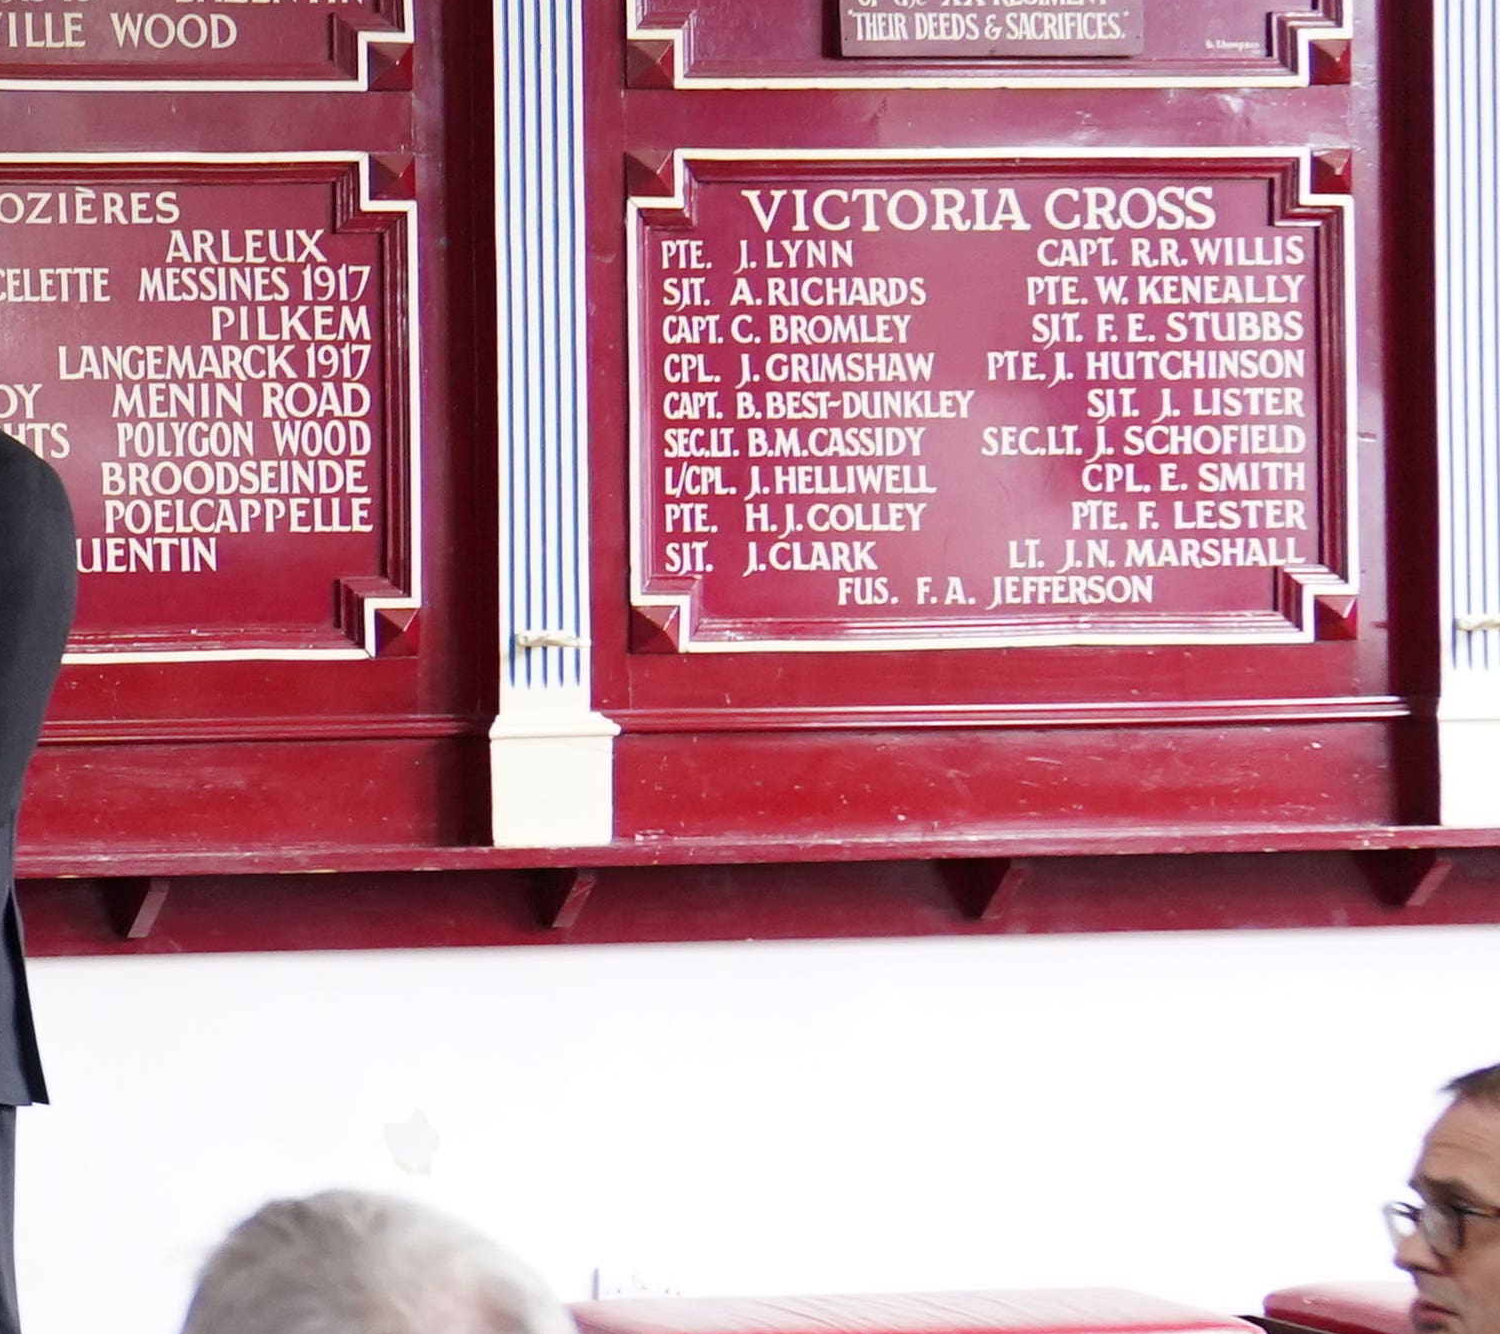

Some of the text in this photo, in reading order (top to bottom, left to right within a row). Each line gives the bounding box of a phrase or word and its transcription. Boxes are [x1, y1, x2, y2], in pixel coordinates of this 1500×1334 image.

[111, 13, 236, 48] WOOD
[915, 13, 979, 40] DEEDS
[742, 187, 1215, 232] VICTORIA CROSS
[166, 230, 326, 264] ARLEUX
[662, 240, 711, 269] PTE.
[767, 240, 852, 268] LYNN
[1038, 238, 1117, 266] CAPT.
[1191, 236, 1304, 265] WILLIS
[139, 264, 370, 301] MESSINES 1917
[768, 277, 926, 307] RICHARDS
[1027, 276, 1088, 305] PTE.
[1139, 275, 1304, 304] KENEALLY
[212, 306, 370, 340] PILKEM
[663, 315, 723, 343] CAPT.
[770, 315, 911, 344] BROMLEY
[1167, 311, 1303, 341] STUBBS
[59, 343, 371, 380] LANGEMARCK 1917
[664, 354, 720, 382] CPL.
[766, 353, 934, 383] GRIMSHAW
[1087, 349, 1304, 380] HUTCHINSON
[112, 382, 370, 419] MENIN ROAD
[664, 392, 723, 419] CAPT.
[1194, 387, 1304, 417] LISTER
[117, 420, 370, 457] POLYGON WOOD
[1124, 425, 1306, 455] SCHOFIELD
[101, 460, 367, 496] BROODSEINDE
[775, 465, 937, 493] HELLIWELL
[1082, 464, 1150, 492] CPL.
[1199, 462, 1305, 491] SMITH
[105, 498, 372, 533] POELCAPPELLE
[665, 503, 717, 532] PTE.
[808, 503, 927, 531] COLLEY
[1072, 500, 1127, 530] PTE.
[1174, 500, 1307, 530] LESTER
[769, 542, 878, 572] CLARK
[1125, 538, 1305, 568] MARSHALL
[839, 577, 898, 605] FUS.
[987, 575, 1153, 609] JEFFERSON
